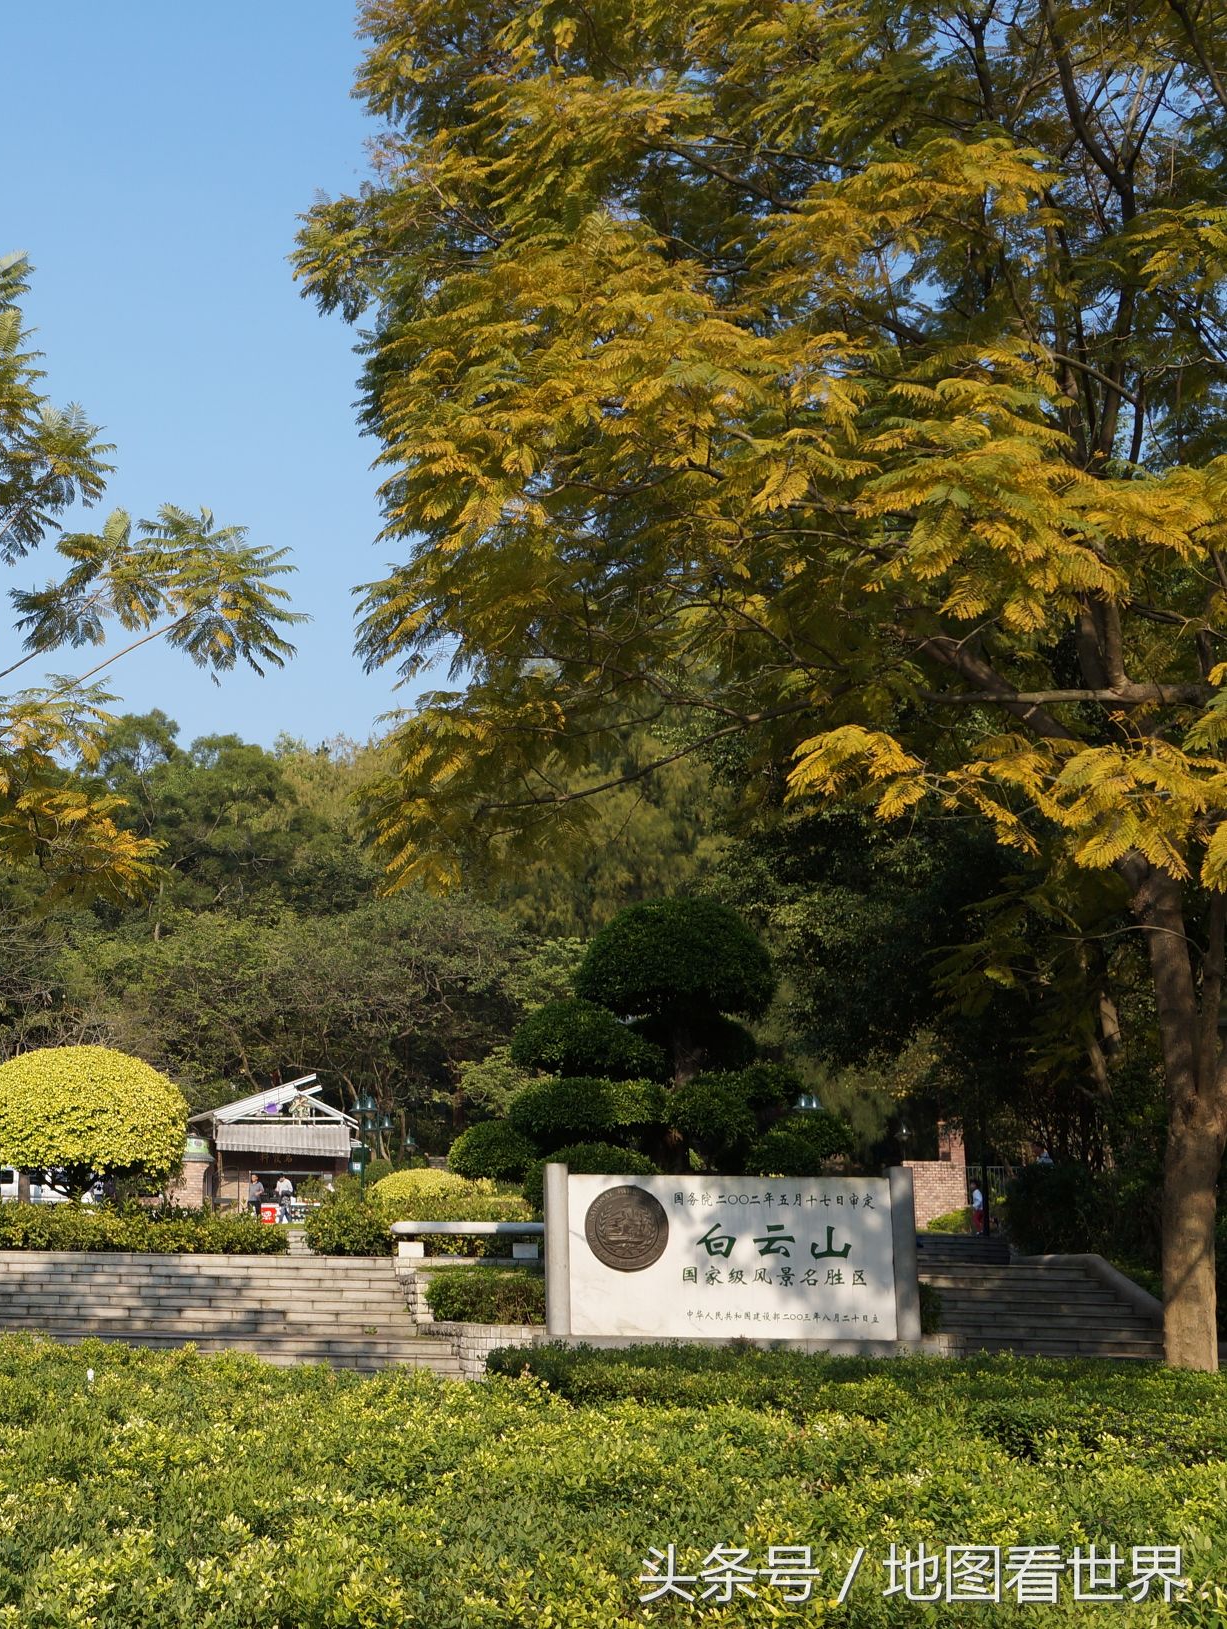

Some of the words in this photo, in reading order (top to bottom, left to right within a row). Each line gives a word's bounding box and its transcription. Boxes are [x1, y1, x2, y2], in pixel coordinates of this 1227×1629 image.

[696, 1222, 853, 1260] 白云山
[682, 1265, 868, 1287] 国家级风景名胜区
